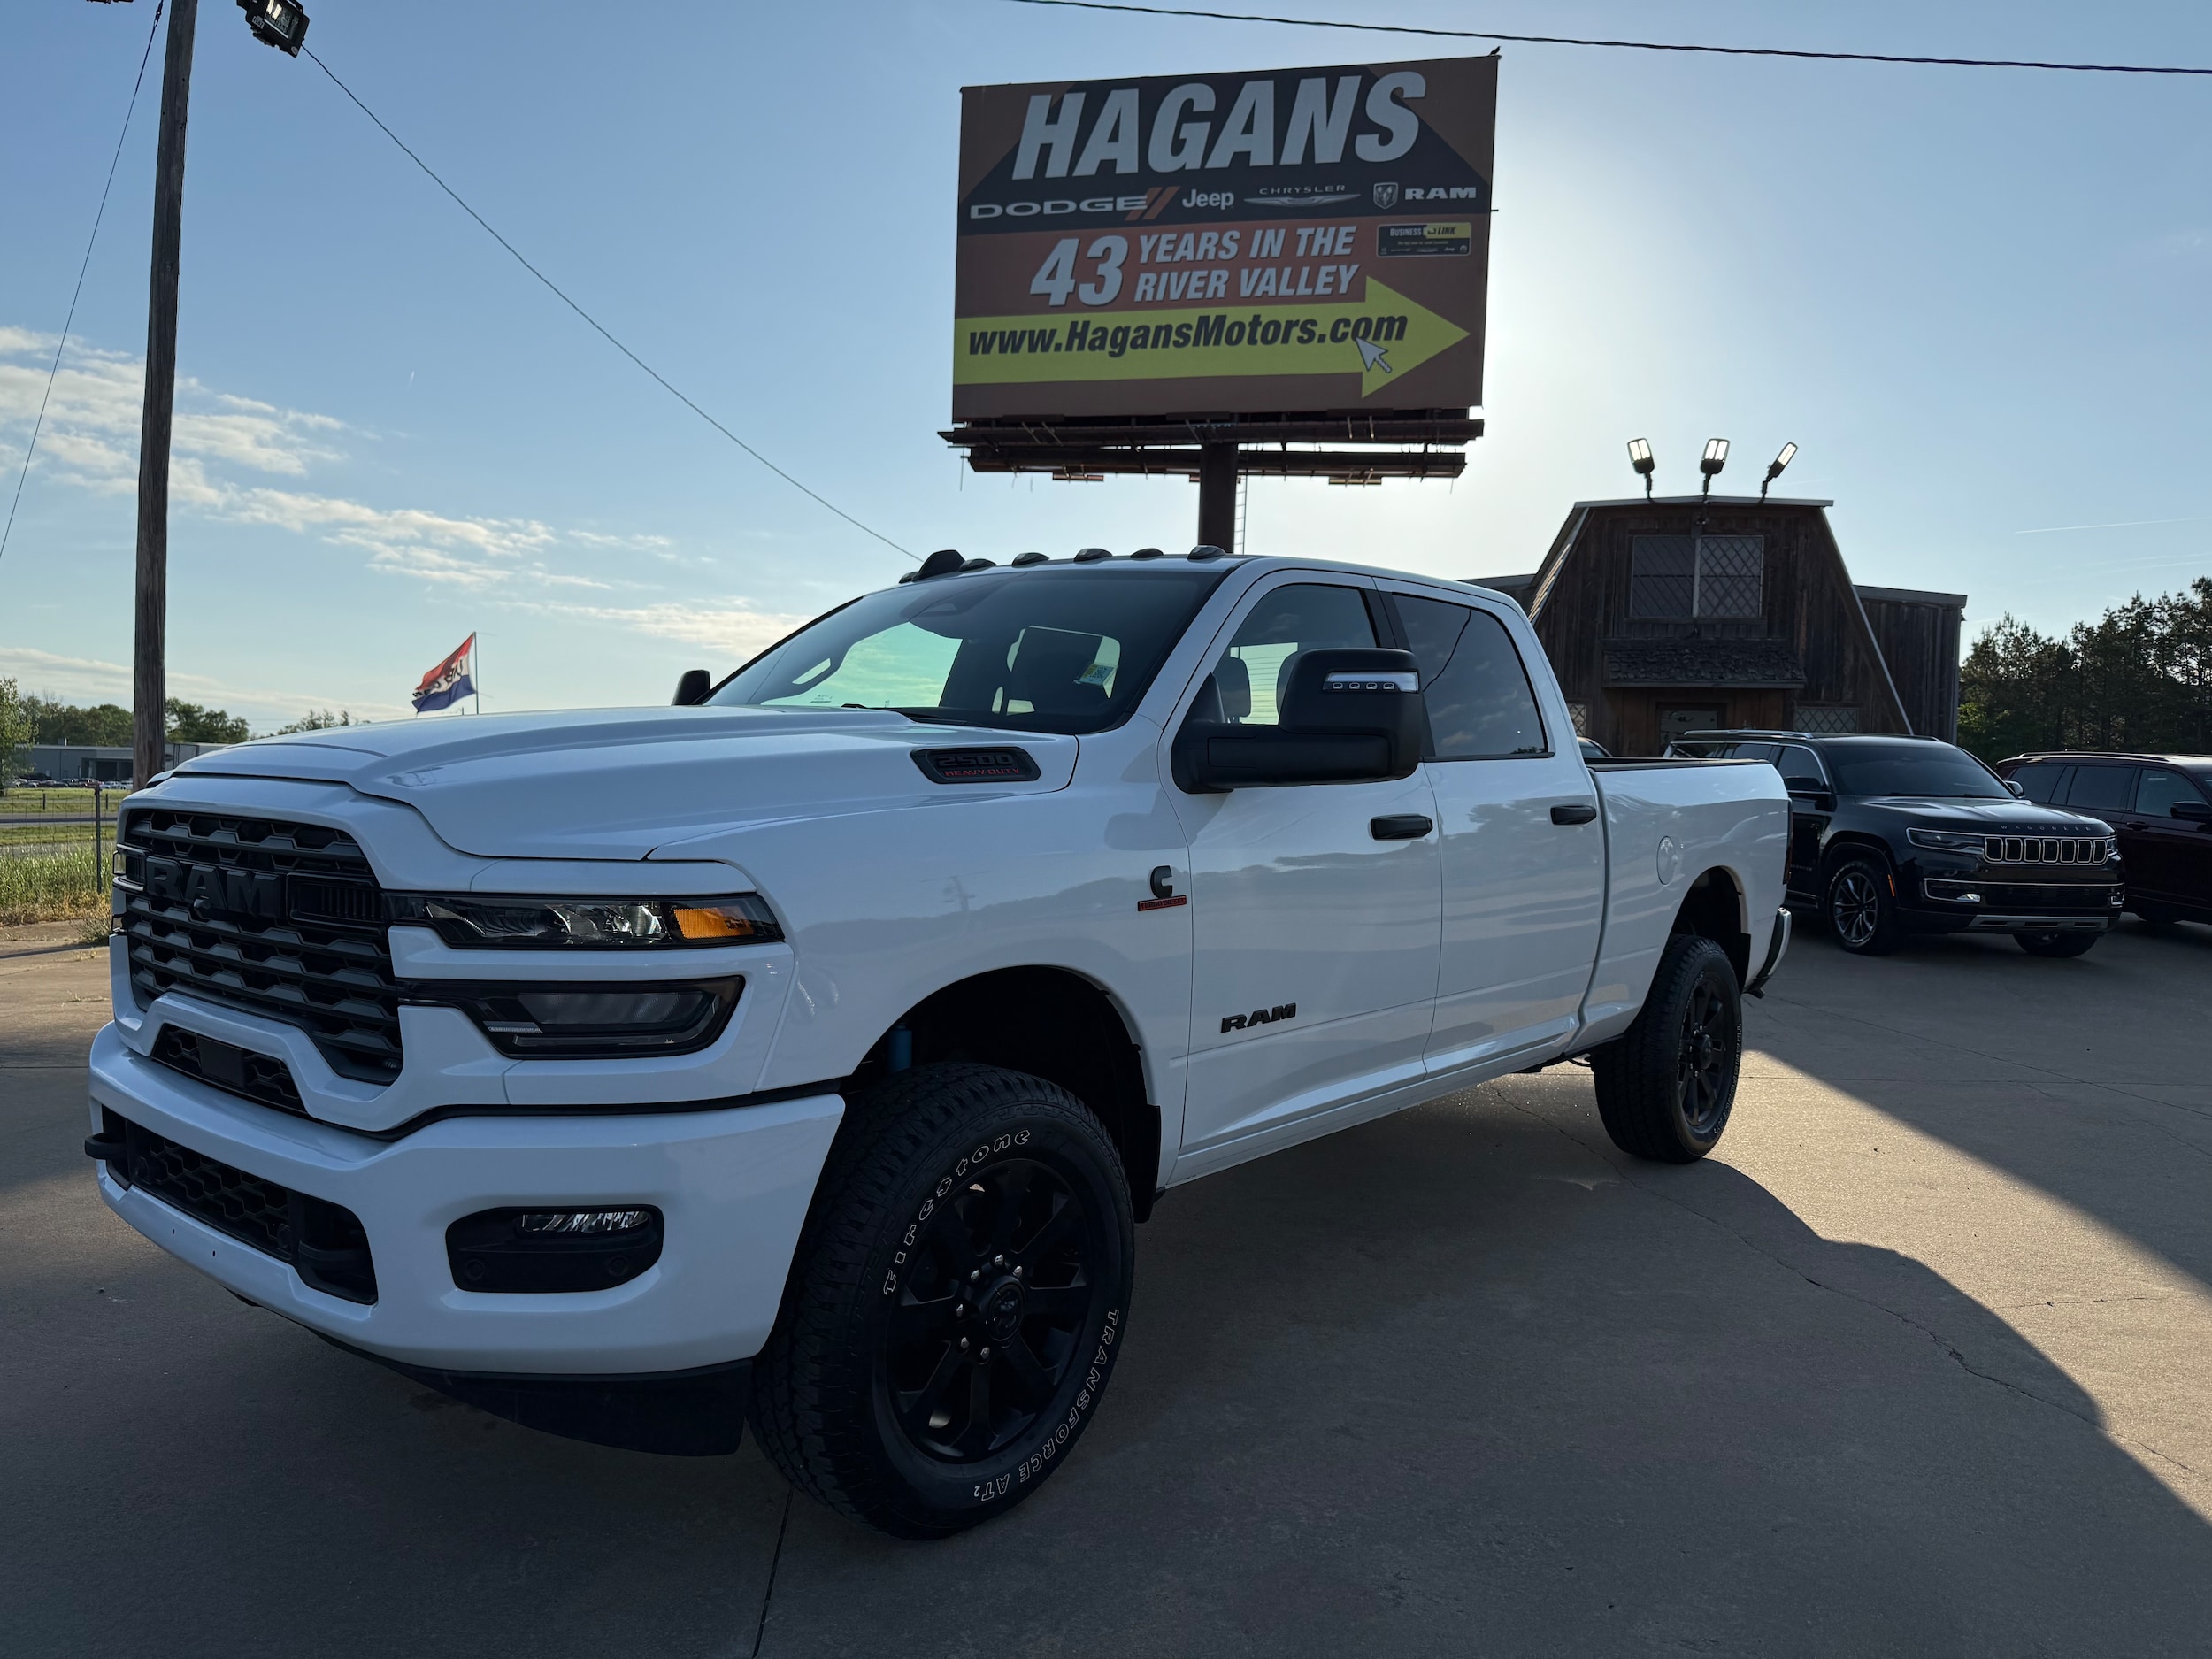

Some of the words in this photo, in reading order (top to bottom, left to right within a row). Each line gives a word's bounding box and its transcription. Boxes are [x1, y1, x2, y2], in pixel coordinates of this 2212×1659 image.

[1011, 71, 1426, 180] HAGANS
[970, 195, 1148, 219] DODGE
[1181, 188, 1235, 211] Jeep
[1258, 184, 1347, 196] CHRYSLER
[1404, 187, 1478, 200] RAM
[1139, 230, 1240, 264] YEARS
[1248, 228, 1287, 259] IN
[1295, 226, 1358, 257] THE
[1029, 235, 1129, 307] 43
[1133, 268, 1231, 303] RIVER
[1239, 264, 1361, 297] VALLEY
[969, 314, 1409, 357] www.HagansMotors.com
[938, 754, 1014, 767] 2500
[145, 855, 282, 918] RAM
[1220, 1002, 1297, 1034] RAM
[1018, 1308, 1120, 1484] TRANSFORCE
